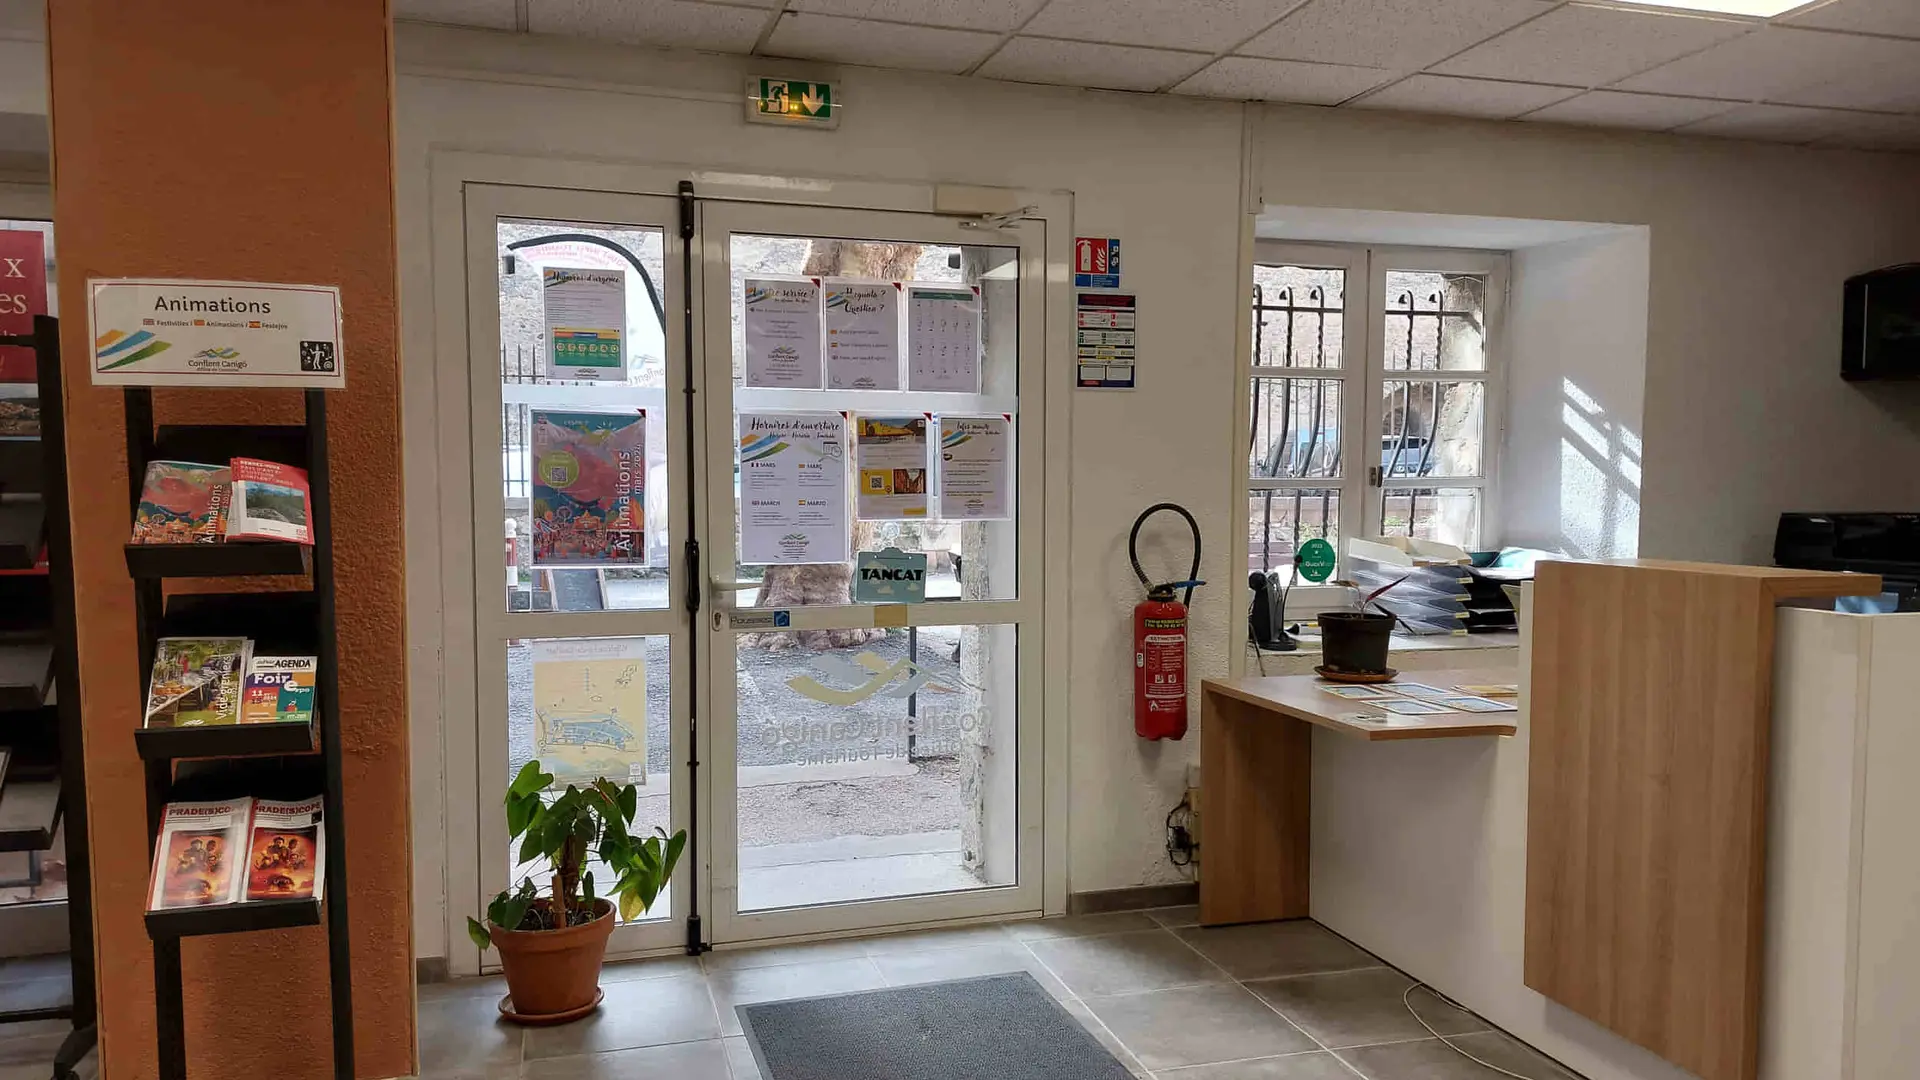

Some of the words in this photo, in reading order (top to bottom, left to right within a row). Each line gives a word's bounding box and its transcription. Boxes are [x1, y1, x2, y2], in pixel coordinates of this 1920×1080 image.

[154, 295, 272, 315] Animations
[156, 319, 189, 328] Festivities
[206, 321, 245, 330] Animations
[262, 322, 288, 331] Festejos
[188, 359, 221, 368] Conflent
[750, 416, 791, 431] Horaires
[792, 418, 841, 431] d'ouverture
[614, 451, 633, 551] Animations
[202, 484, 223, 544] Animations
[860, 567, 924, 581] TANCAT
[274, 659, 311, 669] AGENDA
[168, 803, 238, 816] PRADE(S)CO
